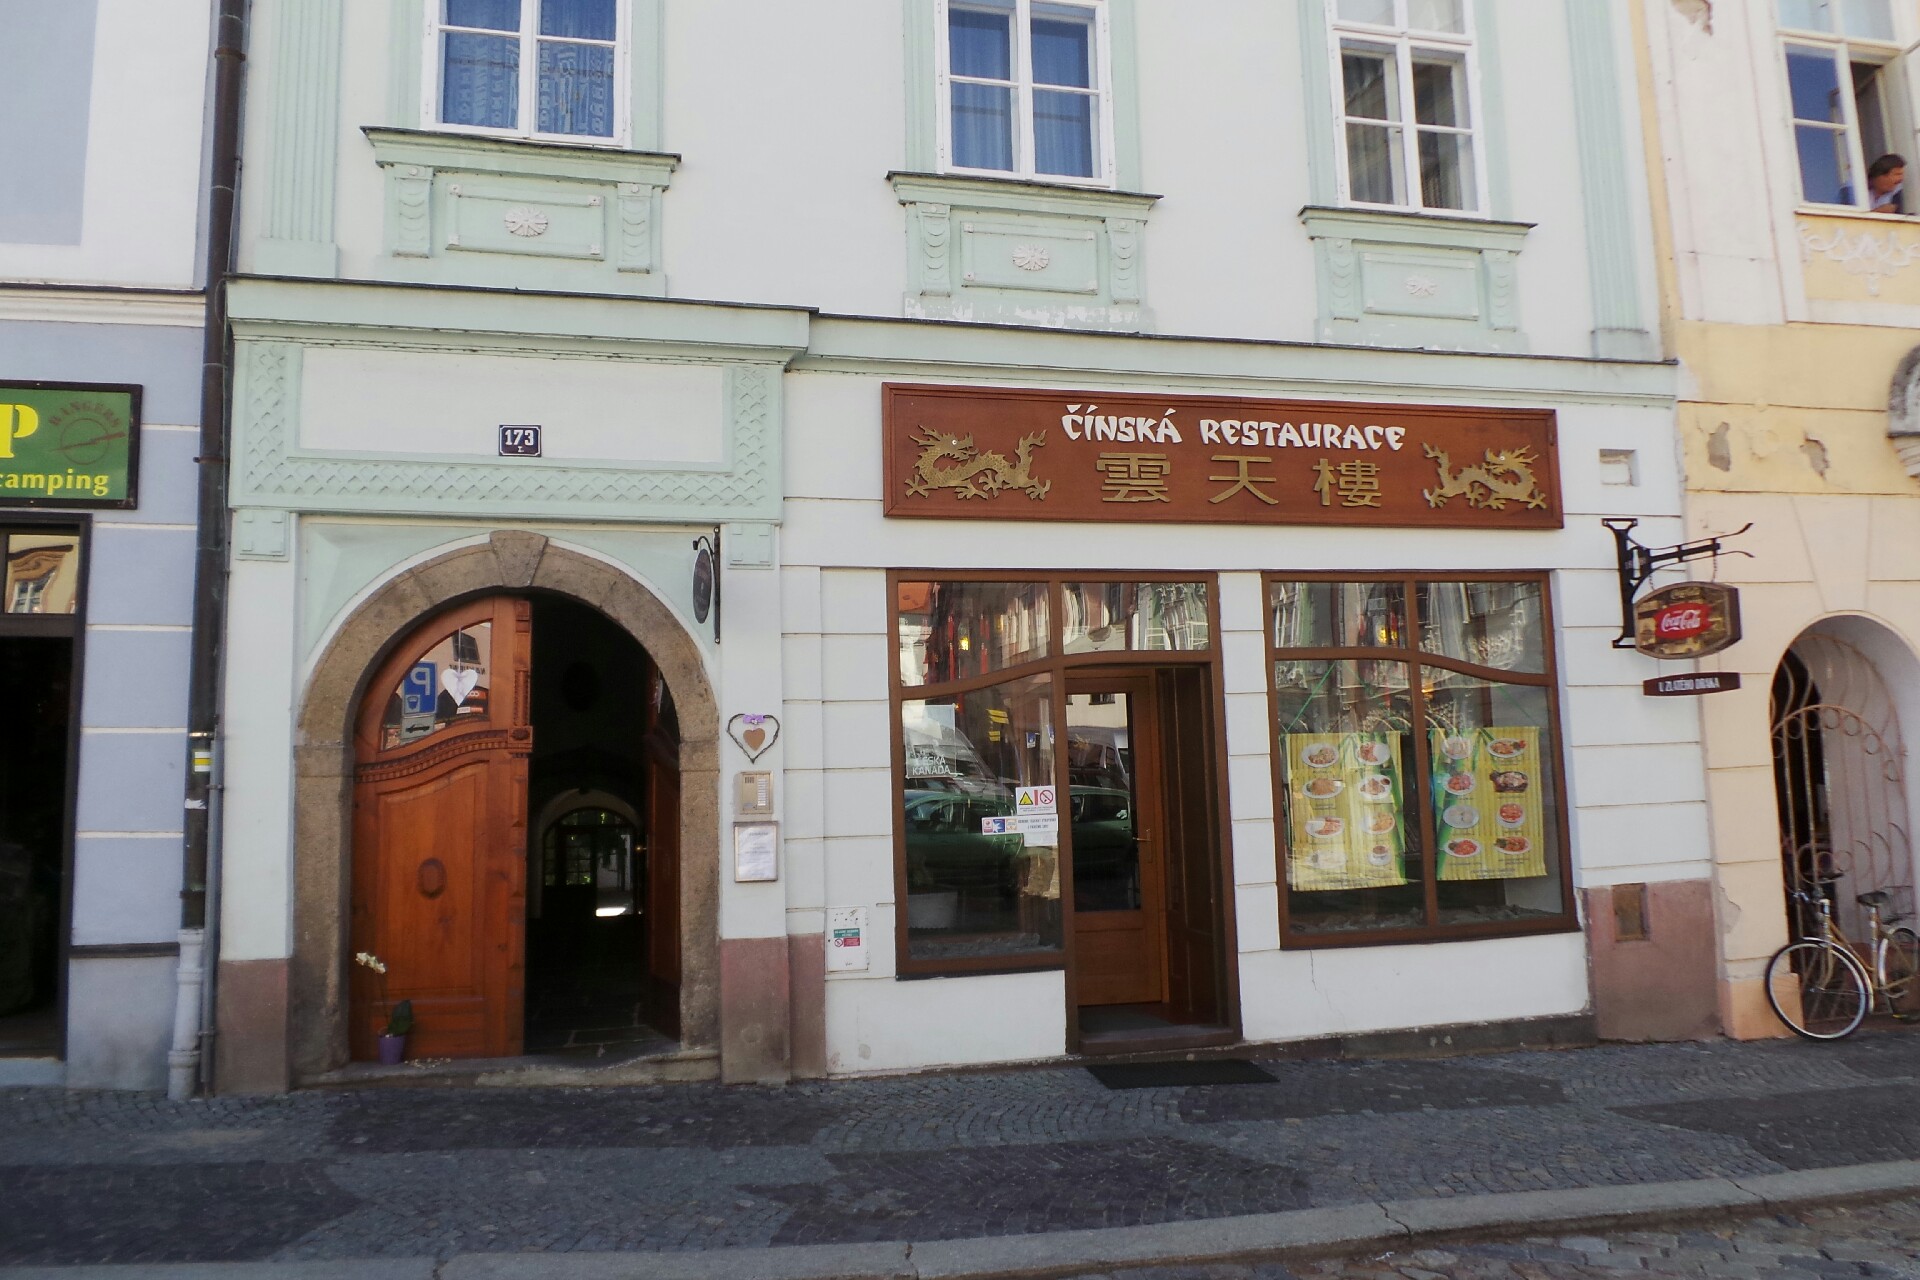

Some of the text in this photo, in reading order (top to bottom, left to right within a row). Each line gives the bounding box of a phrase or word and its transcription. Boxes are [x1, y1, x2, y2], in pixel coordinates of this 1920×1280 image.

[0, 404, 38, 458] P
[505, 430, 534, 446] 173
[1062, 404, 1405, 450] ČÍNSKÁ RESTAURACE
[912, 765, 951, 776] KANADA
